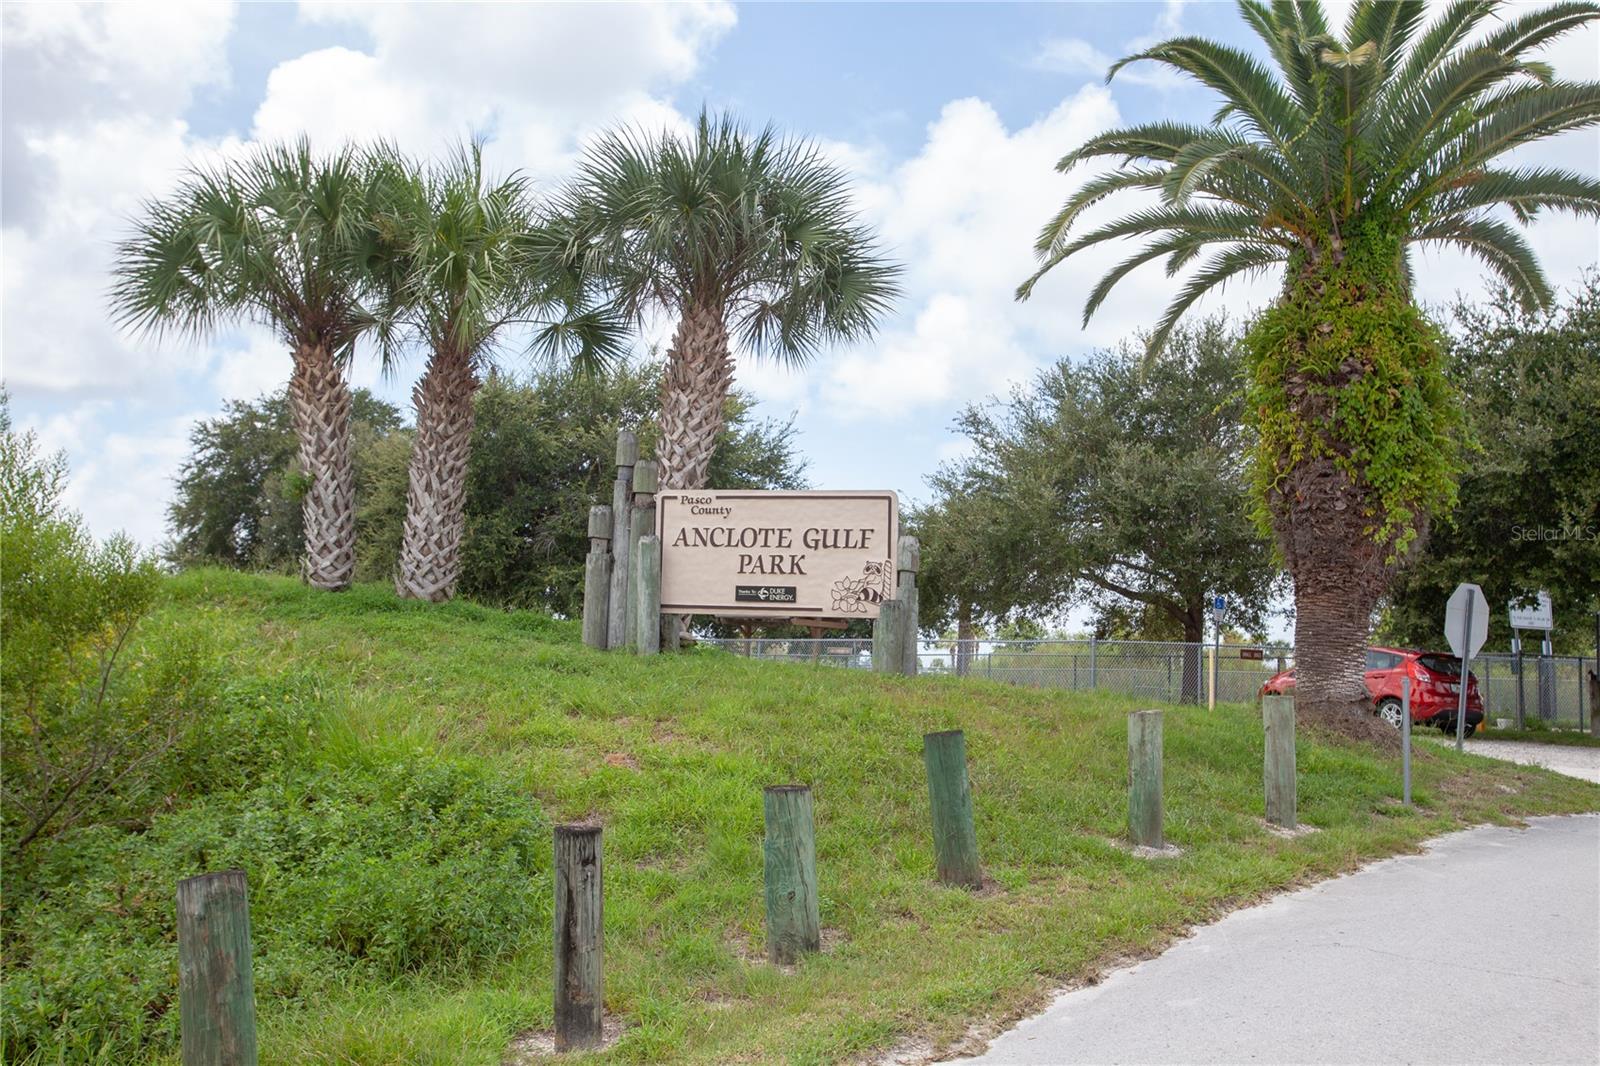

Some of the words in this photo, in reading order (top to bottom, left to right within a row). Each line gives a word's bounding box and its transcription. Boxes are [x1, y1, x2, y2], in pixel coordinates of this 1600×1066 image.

[680, 495, 712, 505] Pasco
[690, 505, 732, 519] County
[672, 527, 792, 549] ANCLOTE
[803, 528, 875, 551] GULF
[737, 554, 807, 575] PARK
